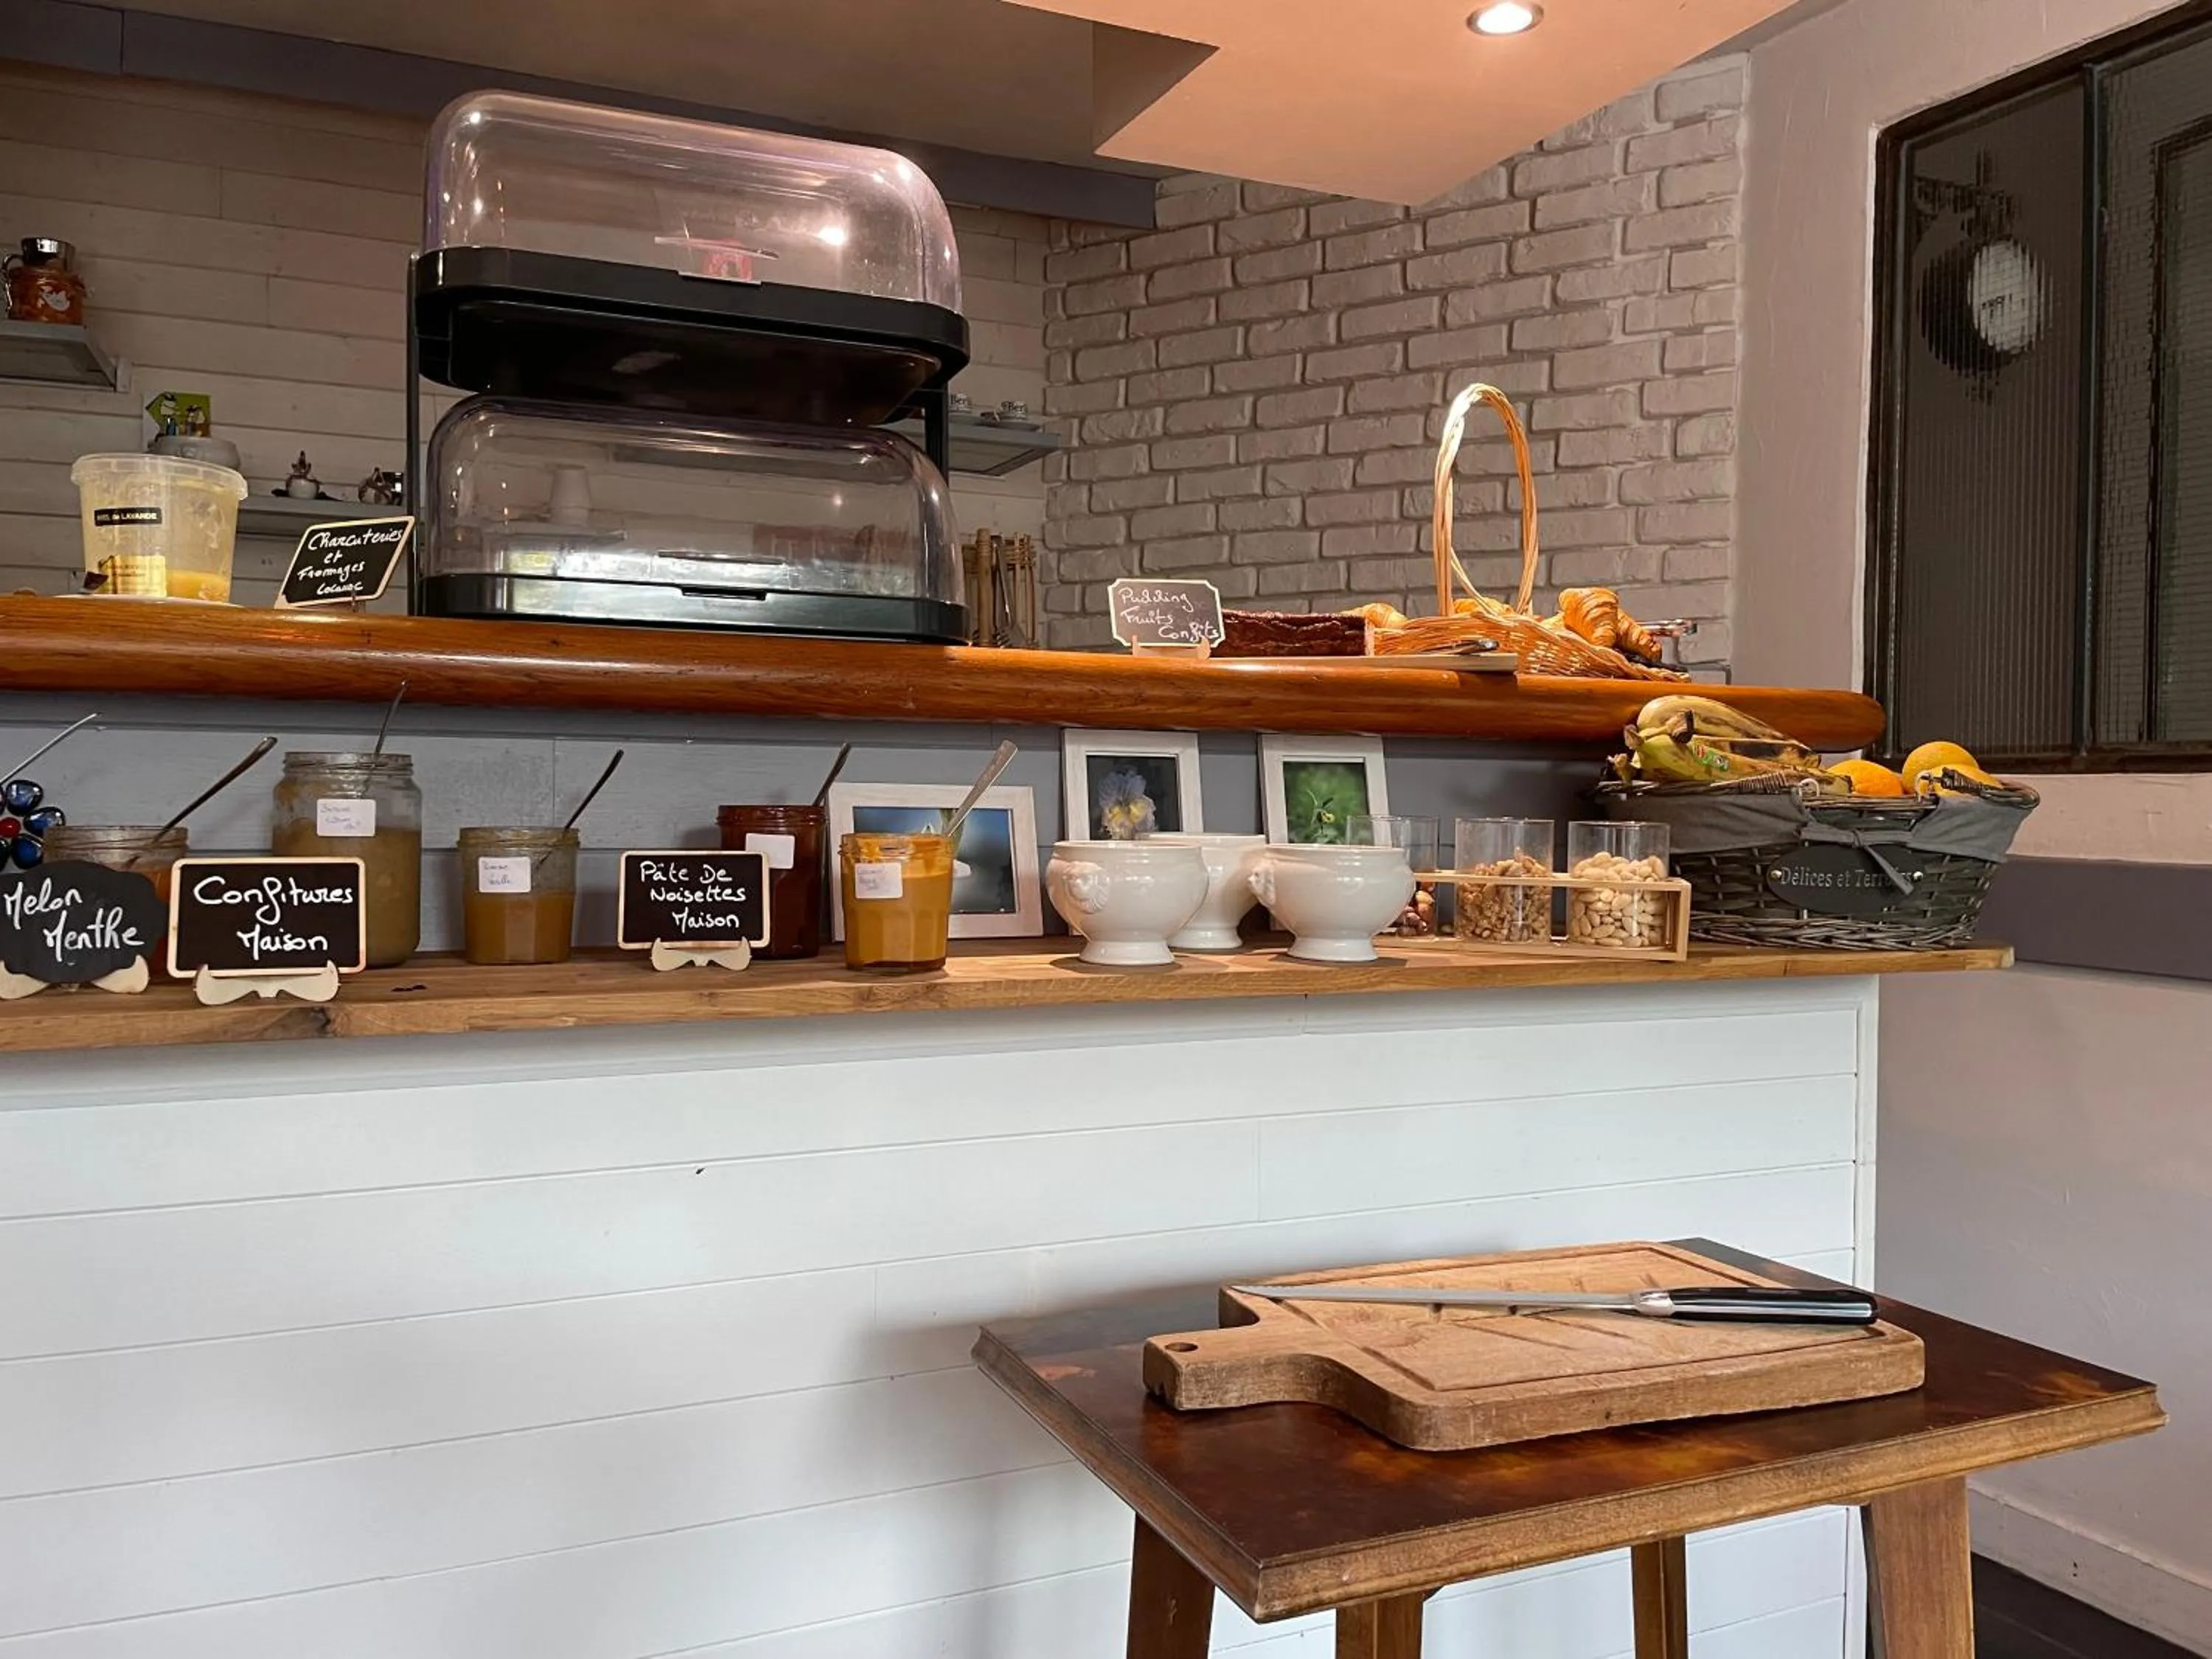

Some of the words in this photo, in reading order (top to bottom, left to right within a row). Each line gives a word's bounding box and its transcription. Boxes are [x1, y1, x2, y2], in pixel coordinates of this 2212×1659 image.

[307, 528, 403, 551] Charcuteries
[324, 549, 343, 564] et
[297, 561, 366, 582] Fromages
[1119, 587, 1194, 613] Pudding
[1120, 605, 1174, 625] Fruits
[1158, 621, 1220, 642] Confits
[700, 864, 732, 883] De
[1837, 870, 1851, 887] et
[4, 877, 83, 930] Melon
[193, 875, 353, 925] Confitures
[650, 885, 746, 902] Noisettes
[672, 906, 740, 933] Maison
[44, 906, 145, 962] Menthe
[237, 924, 329, 960] Maison
